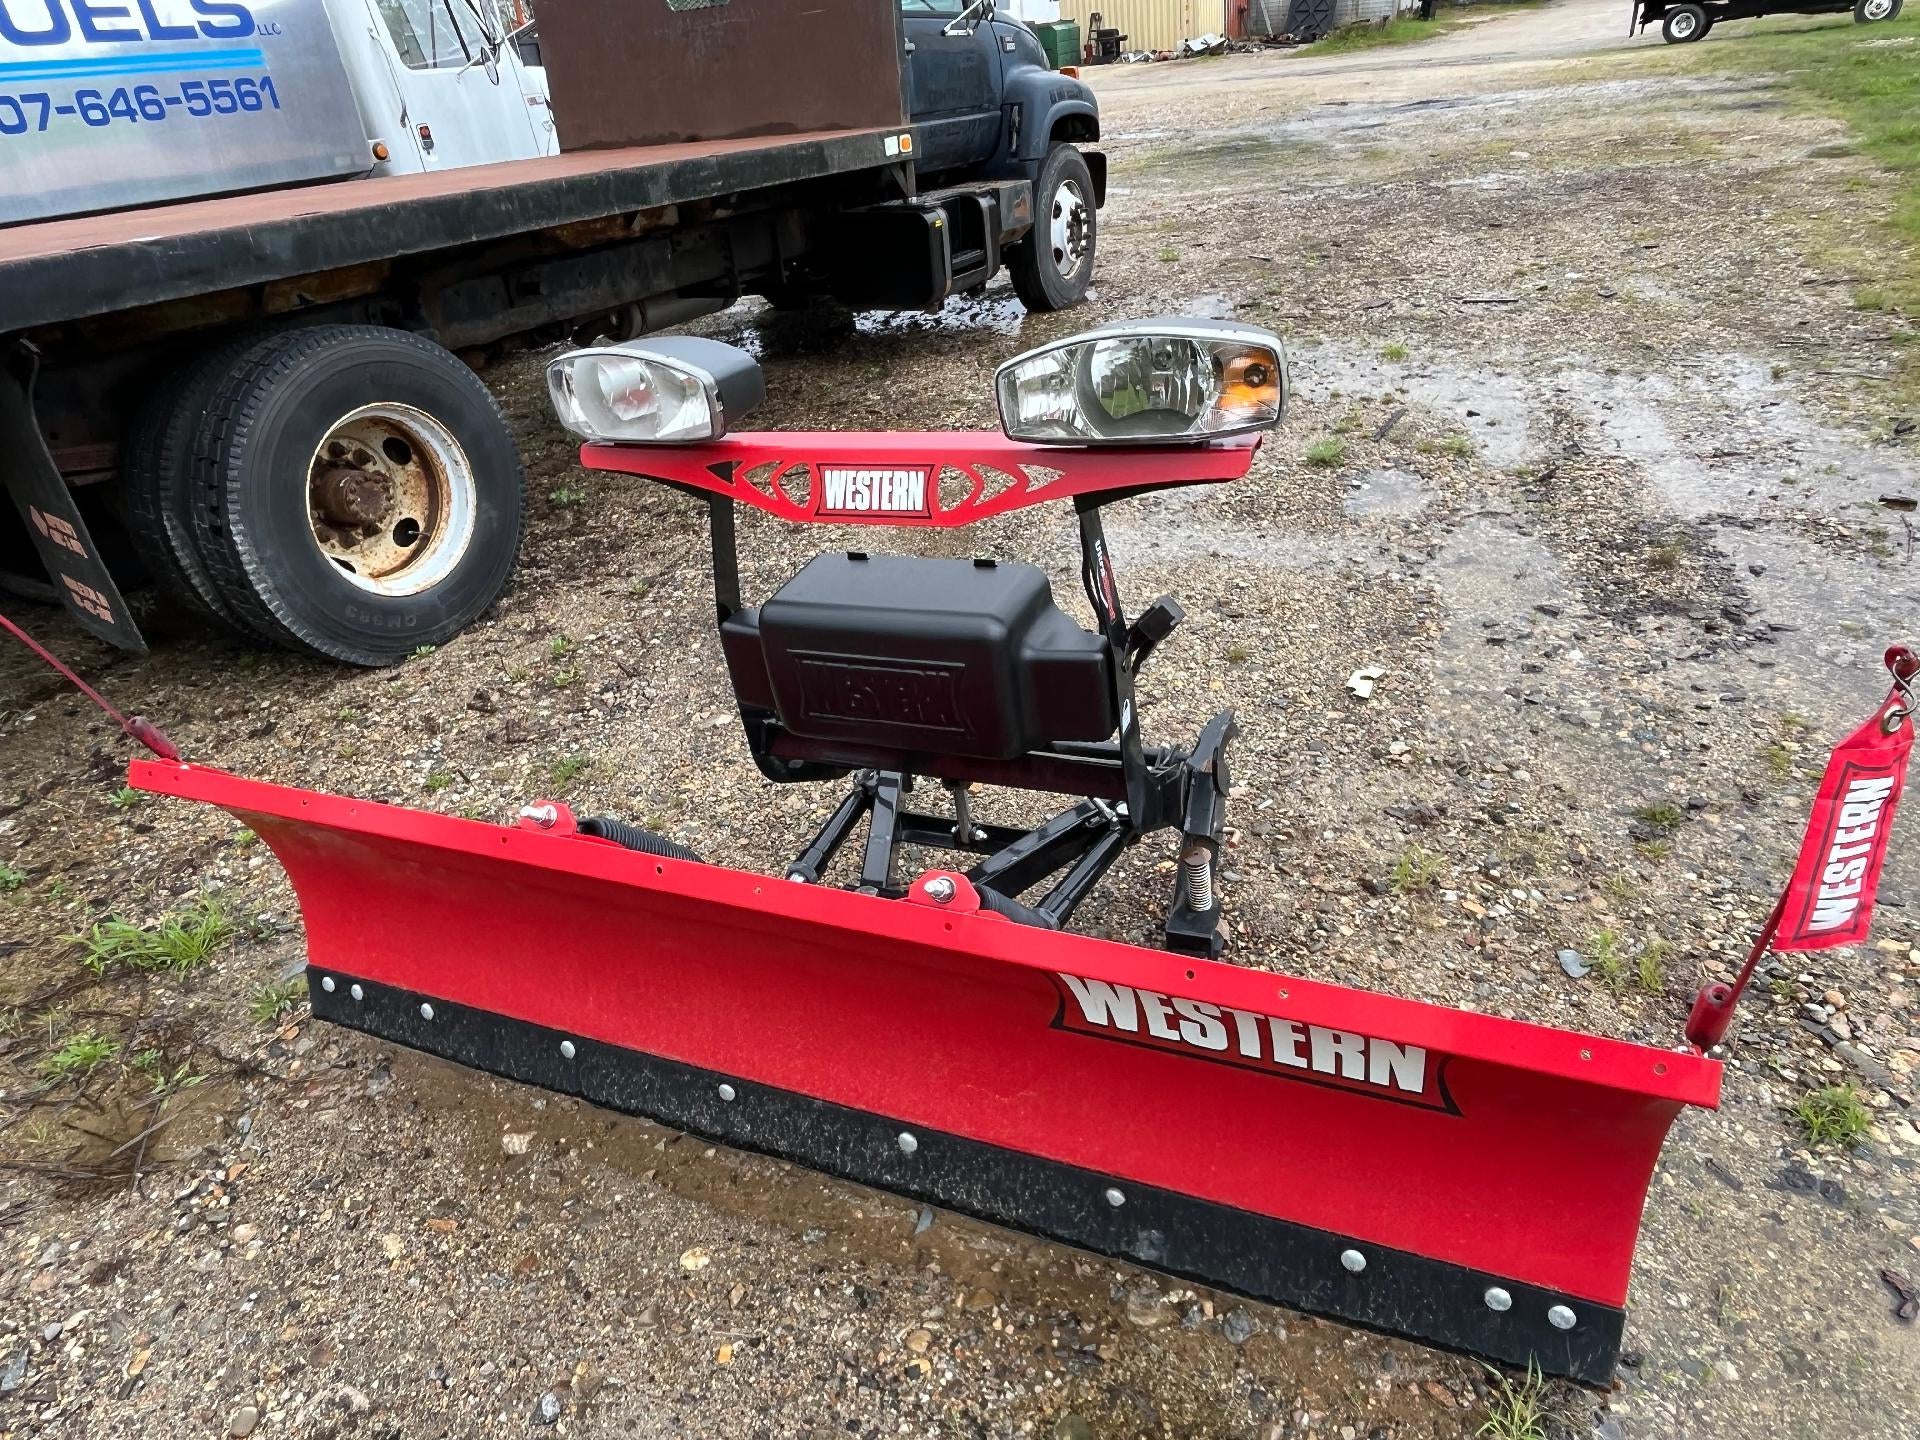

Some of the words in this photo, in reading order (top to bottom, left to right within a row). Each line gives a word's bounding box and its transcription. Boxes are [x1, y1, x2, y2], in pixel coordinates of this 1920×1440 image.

[0, 0, 255, 46] UELS
[257, 23, 282, 36] LLC
[824, 470, 925, 511] WESTERN
[1807, 776, 1895, 931] WESTERN
[1057, 972, 1427, 1094] WESTERN
